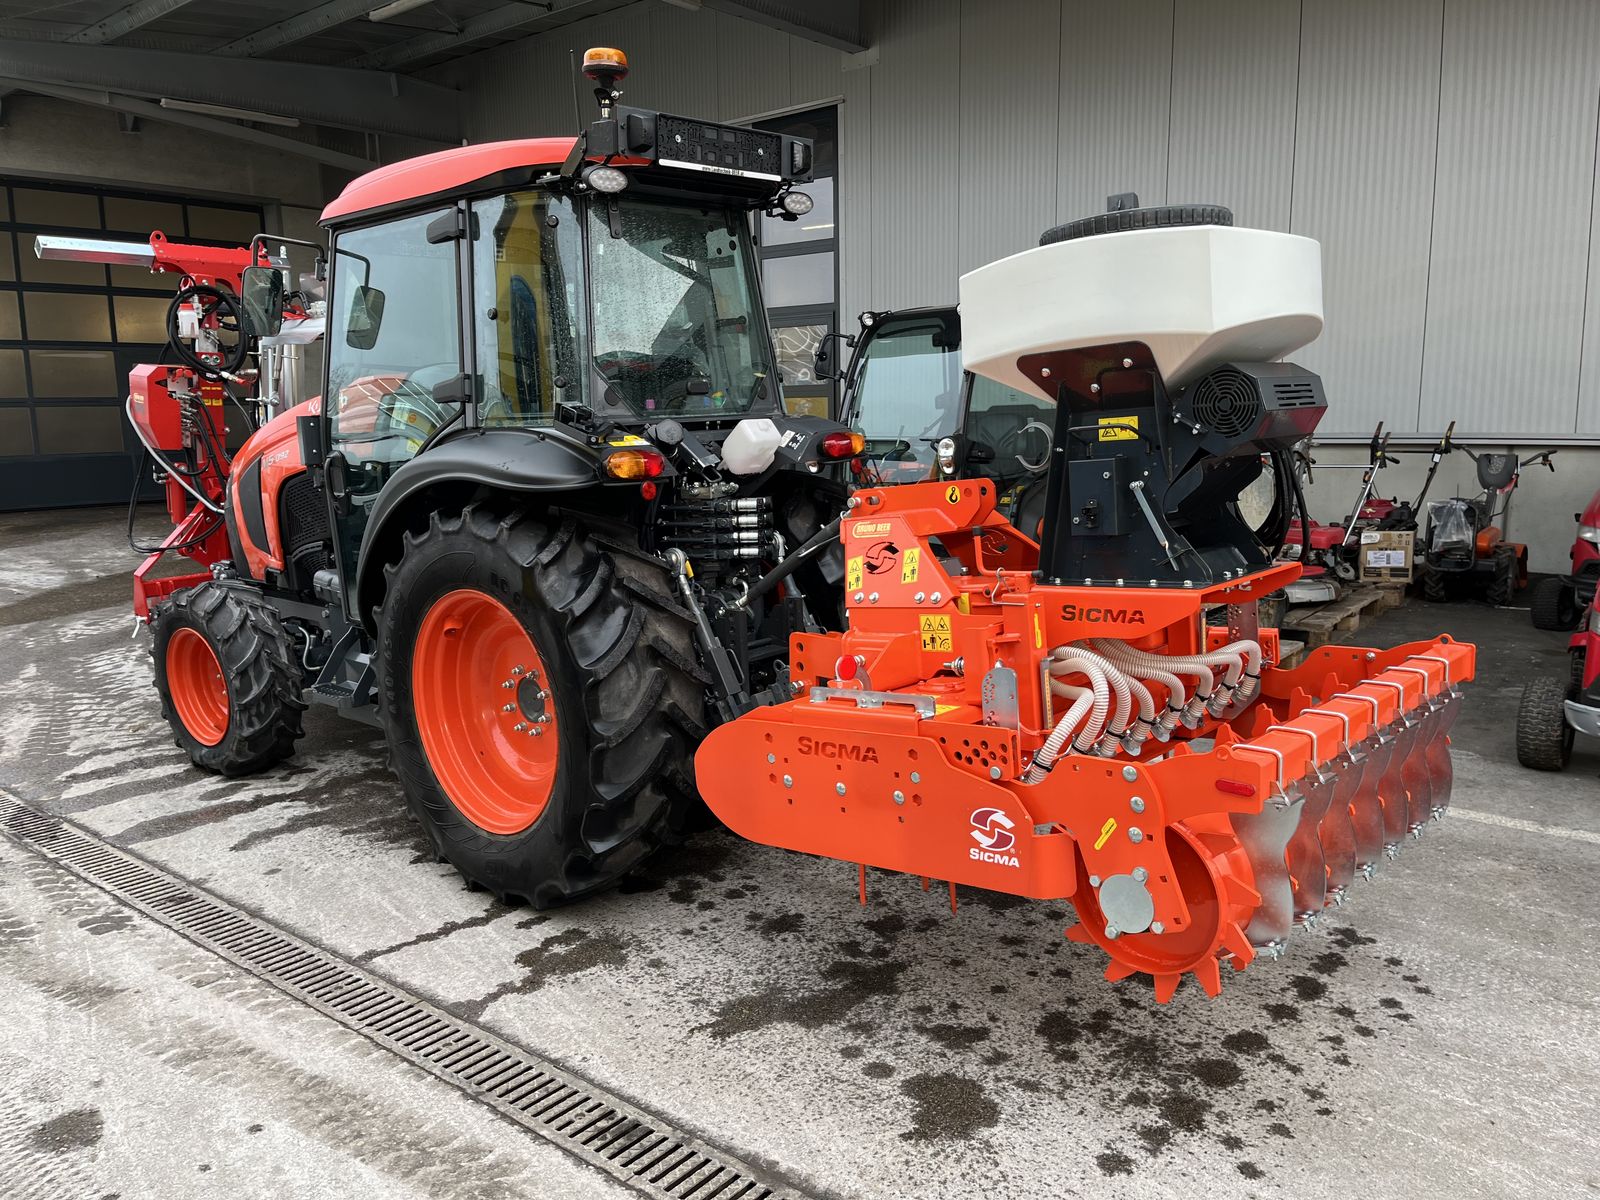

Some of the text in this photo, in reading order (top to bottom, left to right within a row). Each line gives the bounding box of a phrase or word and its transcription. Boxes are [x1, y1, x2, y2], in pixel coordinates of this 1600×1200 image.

[1061, 604, 1145, 624] SICMA
[798, 736, 879, 764] SICMA
[969, 848, 1020, 868] SICMA
